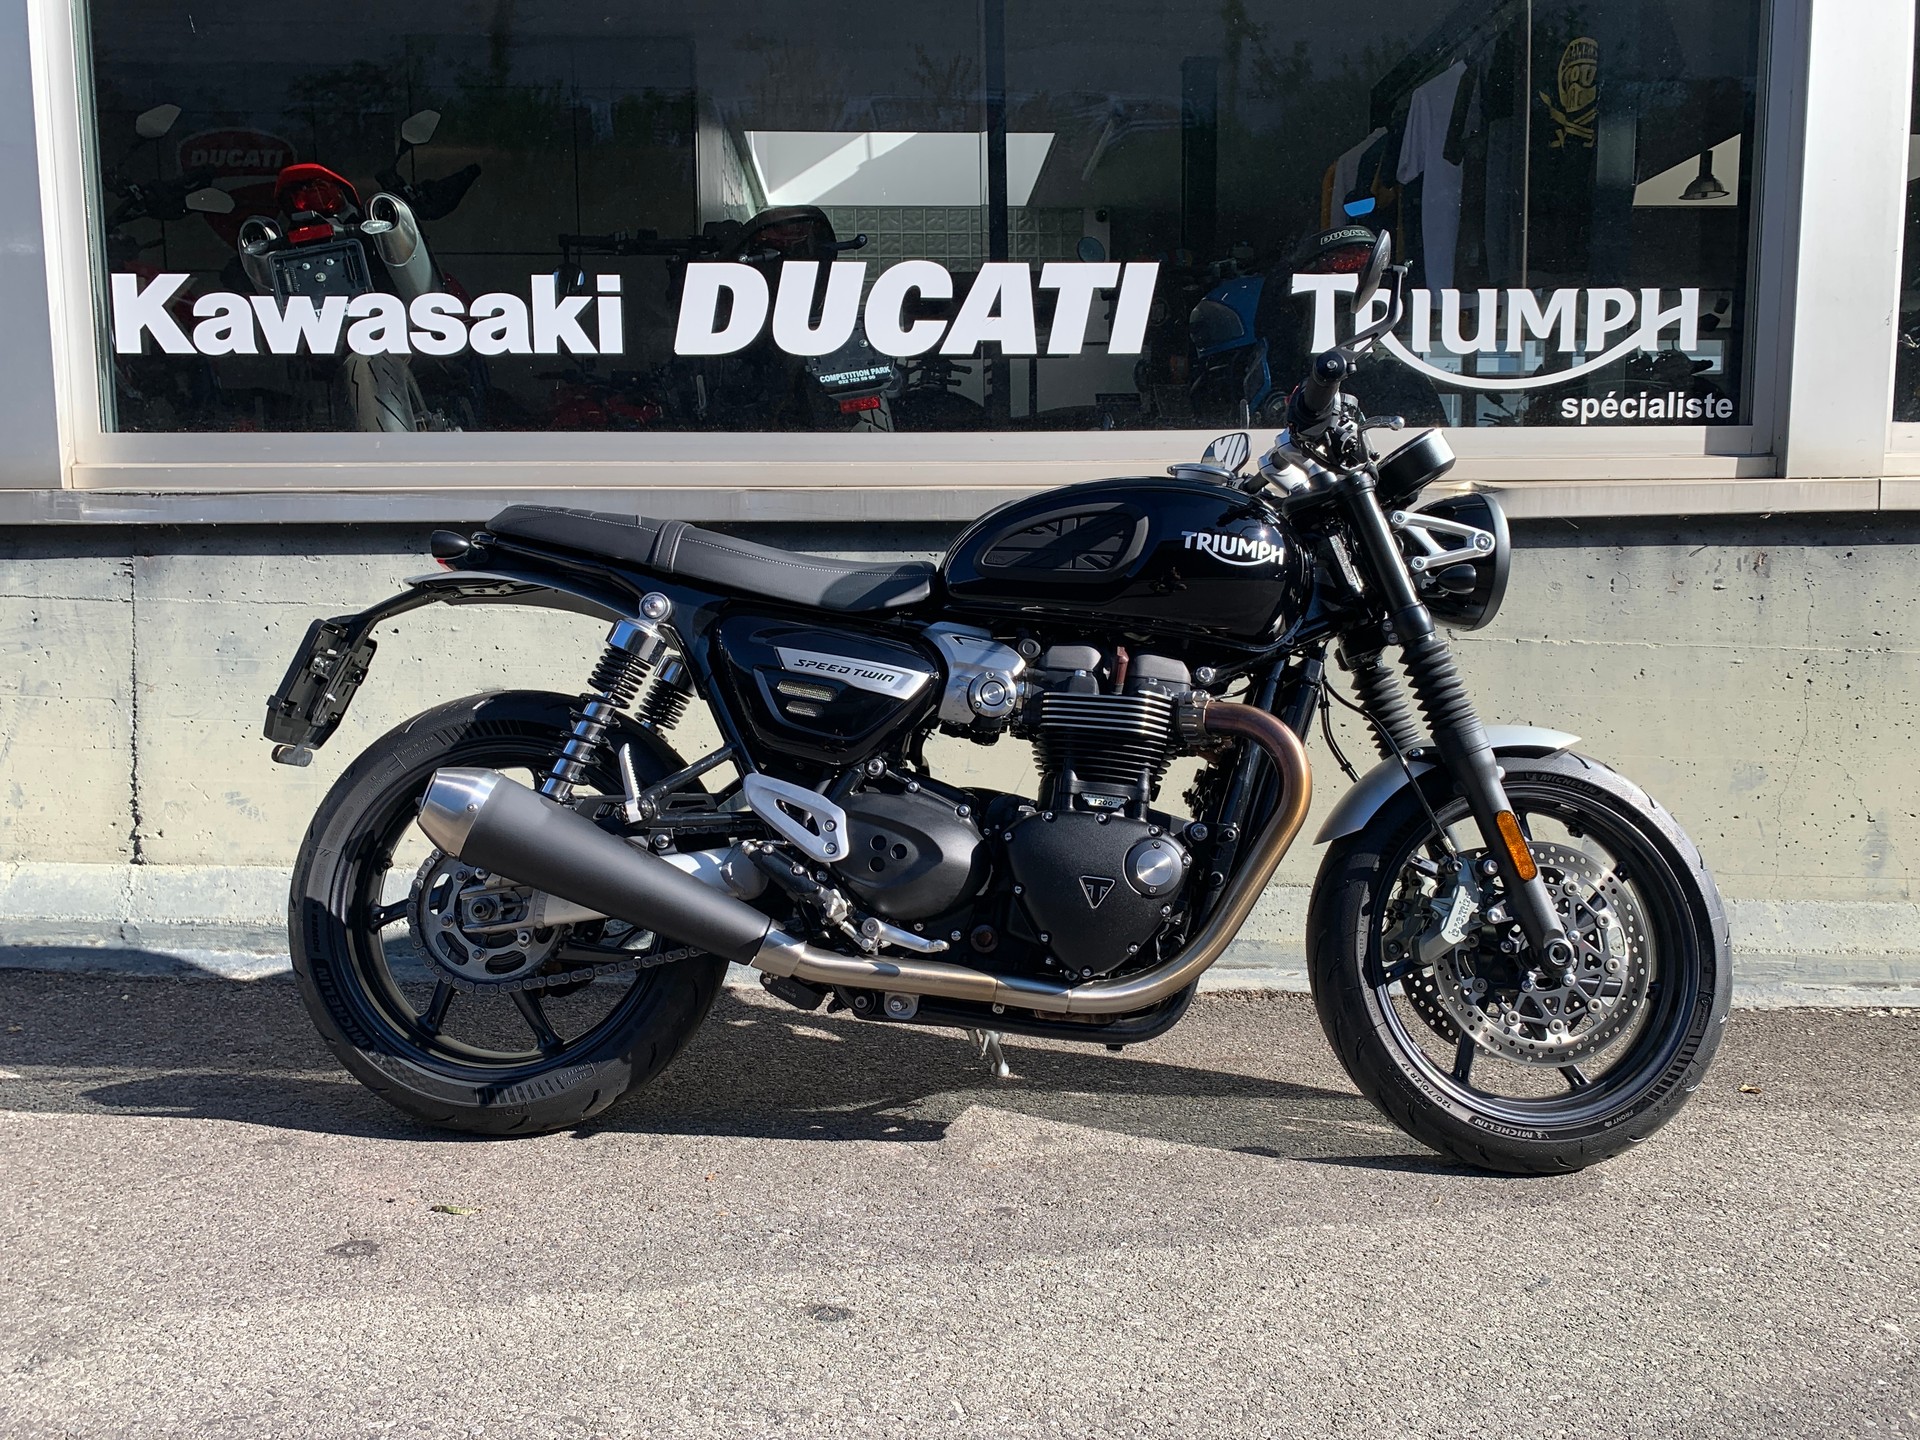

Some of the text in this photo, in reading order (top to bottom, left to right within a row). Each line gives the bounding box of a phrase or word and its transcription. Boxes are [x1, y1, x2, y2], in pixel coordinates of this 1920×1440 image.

[190, 148, 285, 168] DUCATI
[111, 273, 624, 355] Kawasaki
[675, 260, 1160, 357] DUCATI
[1291, 273, 1700, 390] TRIUMPH
[819, 366, 891, 383] COMPETITION PARK
[1561, 391, 1733, 425] spécialiste
[1181, 530, 1286, 567] TRIUMPH
[793, 658, 895, 683] SPEED TWIN
[1539, 773, 1599, 796] MICHELIN
[1093, 798, 1113, 807] 1200
[310, 913, 321, 953] POWER
[314, 967, 371, 1049] MICHELIN
[1401, 1062, 1411, 1072] 17
[1422, 1084, 1452, 1109] 120/70
[1662, 1069, 1694, 1107] POWER
[1474, 1118, 1534, 1139] MICHELIN
[1612, 1109, 1635, 1126] FRONT
